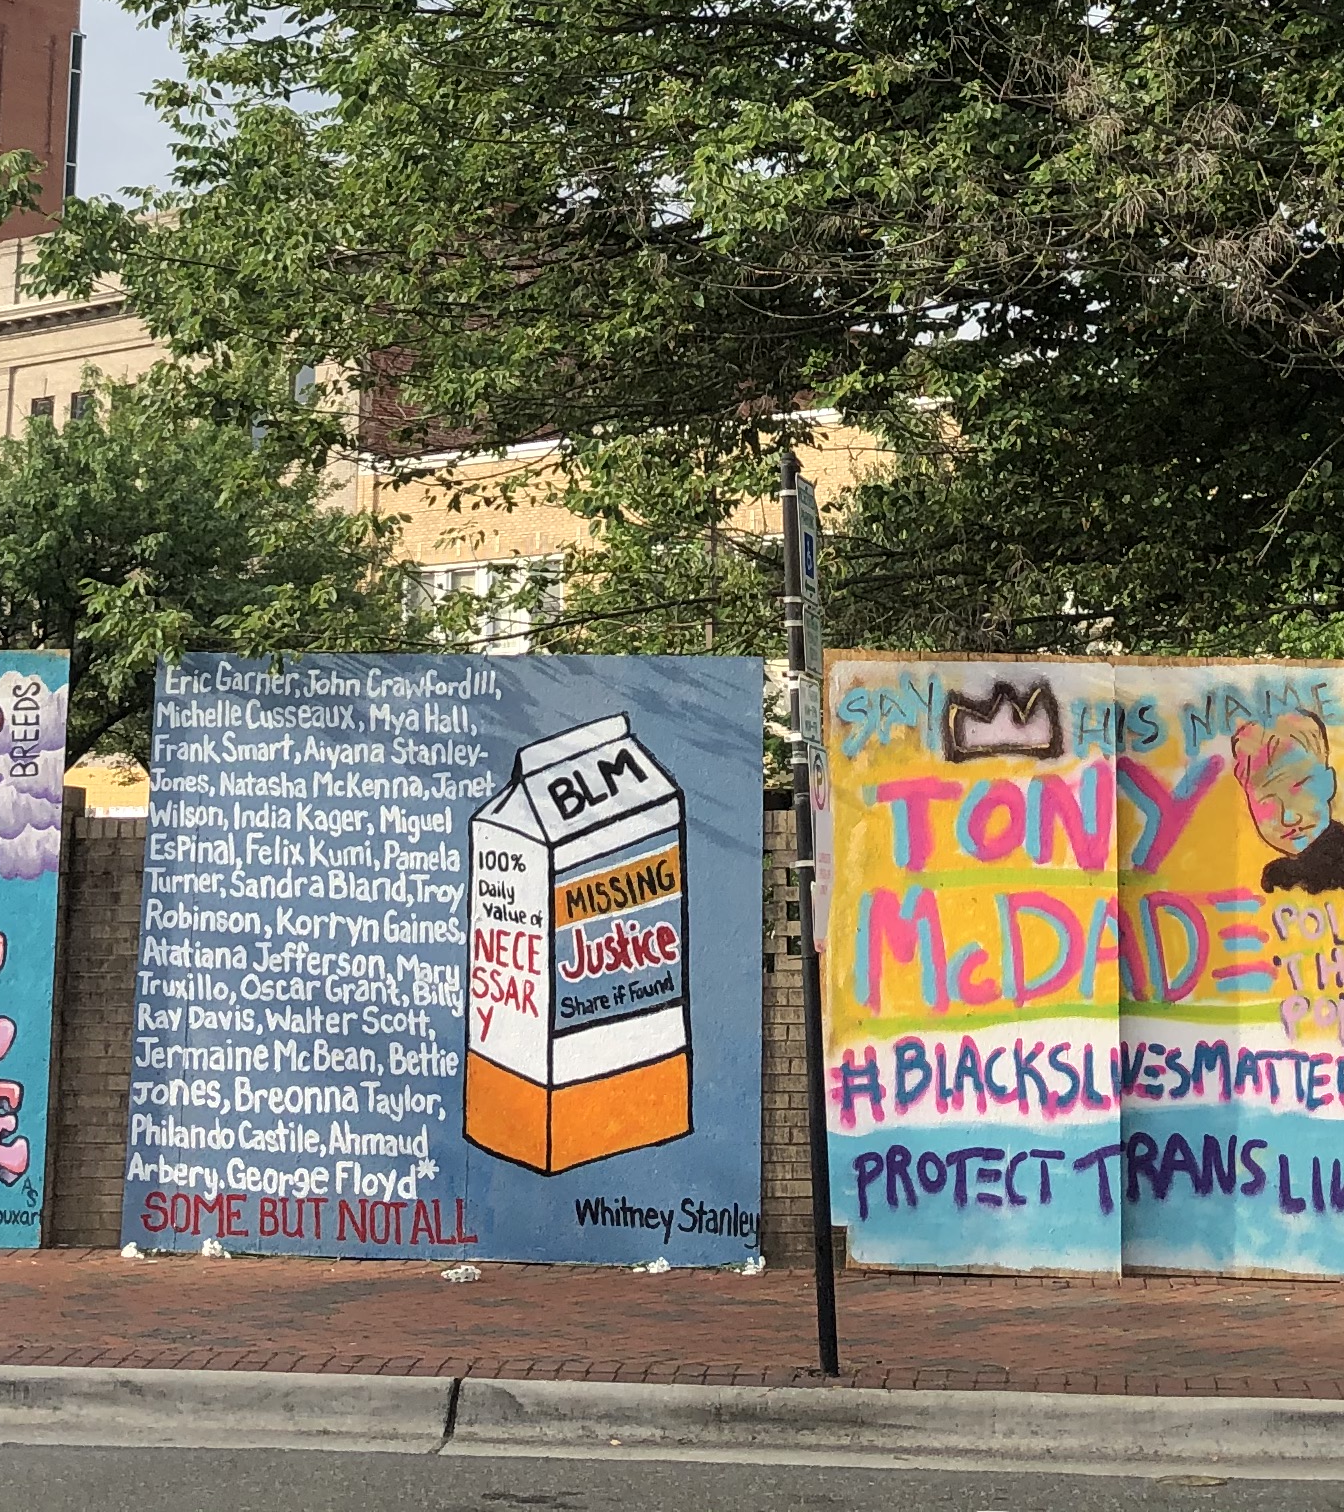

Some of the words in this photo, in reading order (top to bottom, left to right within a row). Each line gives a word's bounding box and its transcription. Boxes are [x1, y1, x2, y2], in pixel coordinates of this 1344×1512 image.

[164, 665, 211, 694] Eric
[215, 661, 300, 699] Garner,
[300, 669, 361, 698] John
[365, 667, 471, 699] Crawford
[10, 681, 41, 777] BREEDS
[155, 700, 241, 729] Michelle
[246, 699, 364, 732] Cusseaux,
[369, 703, 419, 736] Mya
[425, 703, 478, 736] Hall,
[837, 673, 943, 758] SAY
[1071, 703, 1178, 757] HIS
[154, 734, 220, 764] Frank
[222, 731, 301, 765] Smart,
[304, 736, 385, 770] Aiyana
[390, 740, 489, 768] Stanley-
[150, 768, 215, 796] Jones,
[219, 772, 307, 798] Natasha
[313, 772, 430, 802] McKenna,
[431, 772, 496, 800] Janet
[547, 748, 649, 821] BLM
[149, 800, 229, 831] Wilson,
[233, 802, 291, 830] India
[296, 803, 375, 838] Kager,
[379, 804, 453, 844] Miguel
[865, 754, 1225, 873] TONY
[246, 833, 301, 868] Felix
[309, 837, 380, 871] Kumi,
[383, 842, 461, 872] Pamela
[479, 850, 526, 872] 100%
[146, 867, 225, 898] Turner,
[230, 868, 325, 900] Sandra
[329, 869, 414, 908] Bland,
[408, 874, 464, 913] Troy
[479, 879, 515, 905] Daily
[565, 859, 676, 919] MISSING
[145, 902, 272, 939] Robinson,
[277, 906, 380, 946] Korryn
[383, 910, 466, 945] Gaines,
[531, 910, 543, 928] of
[142, 937, 247, 970] Atatiana
[252, 941, 394, 982] Jefferson,
[397, 954, 460, 986] Mary
[473, 928, 543, 976] NECE
[560, 923, 679, 981] Justice
[137, 971, 236, 1005] Truxillo,
[241, 973, 316, 1002] Oscar
[326, 974, 408, 1008] Grant,
[414, 982, 464, 1017] Billy
[471, 967, 539, 1018] SSAR
[560, 986, 611, 1019] Share
[613, 984, 626, 1007] if
[629, 971, 674, 1004] Found
[137, 1003, 182, 1032] Ray
[188, 1004, 263, 1035] Davis,
[265, 1007, 359, 1037] Walter
[362, 1006, 436, 1041] Scott,
[478, 1005, 494, 1043] Y
[135, 1037, 269, 1071] Jermaine
[390, 1041, 459, 1077] Bettie
[132, 1077, 231, 1114] Jones,
[234, 1076, 359, 1115] Breonna
[361, 1081, 446, 1122] Taylor,
[131, 1113, 235, 1149] Philando
[239, 1120, 326, 1158] Castile,
[329, 1120, 429, 1158] Ahmaud
[226, 1156, 328, 1198] George
[853, 1145, 1067, 1223] PROTECT
[1073, 1132, 1269, 1215] TRANS
[140, 1191, 248, 1239] SOME
[259, 1197, 336, 1240] BUT
[337, 1200, 407, 1245] NOT
[410, 1199, 478, 1245] ALL
[575, 1195, 675, 1245] Whitney
[677, 1197, 760, 1249] Stanley
